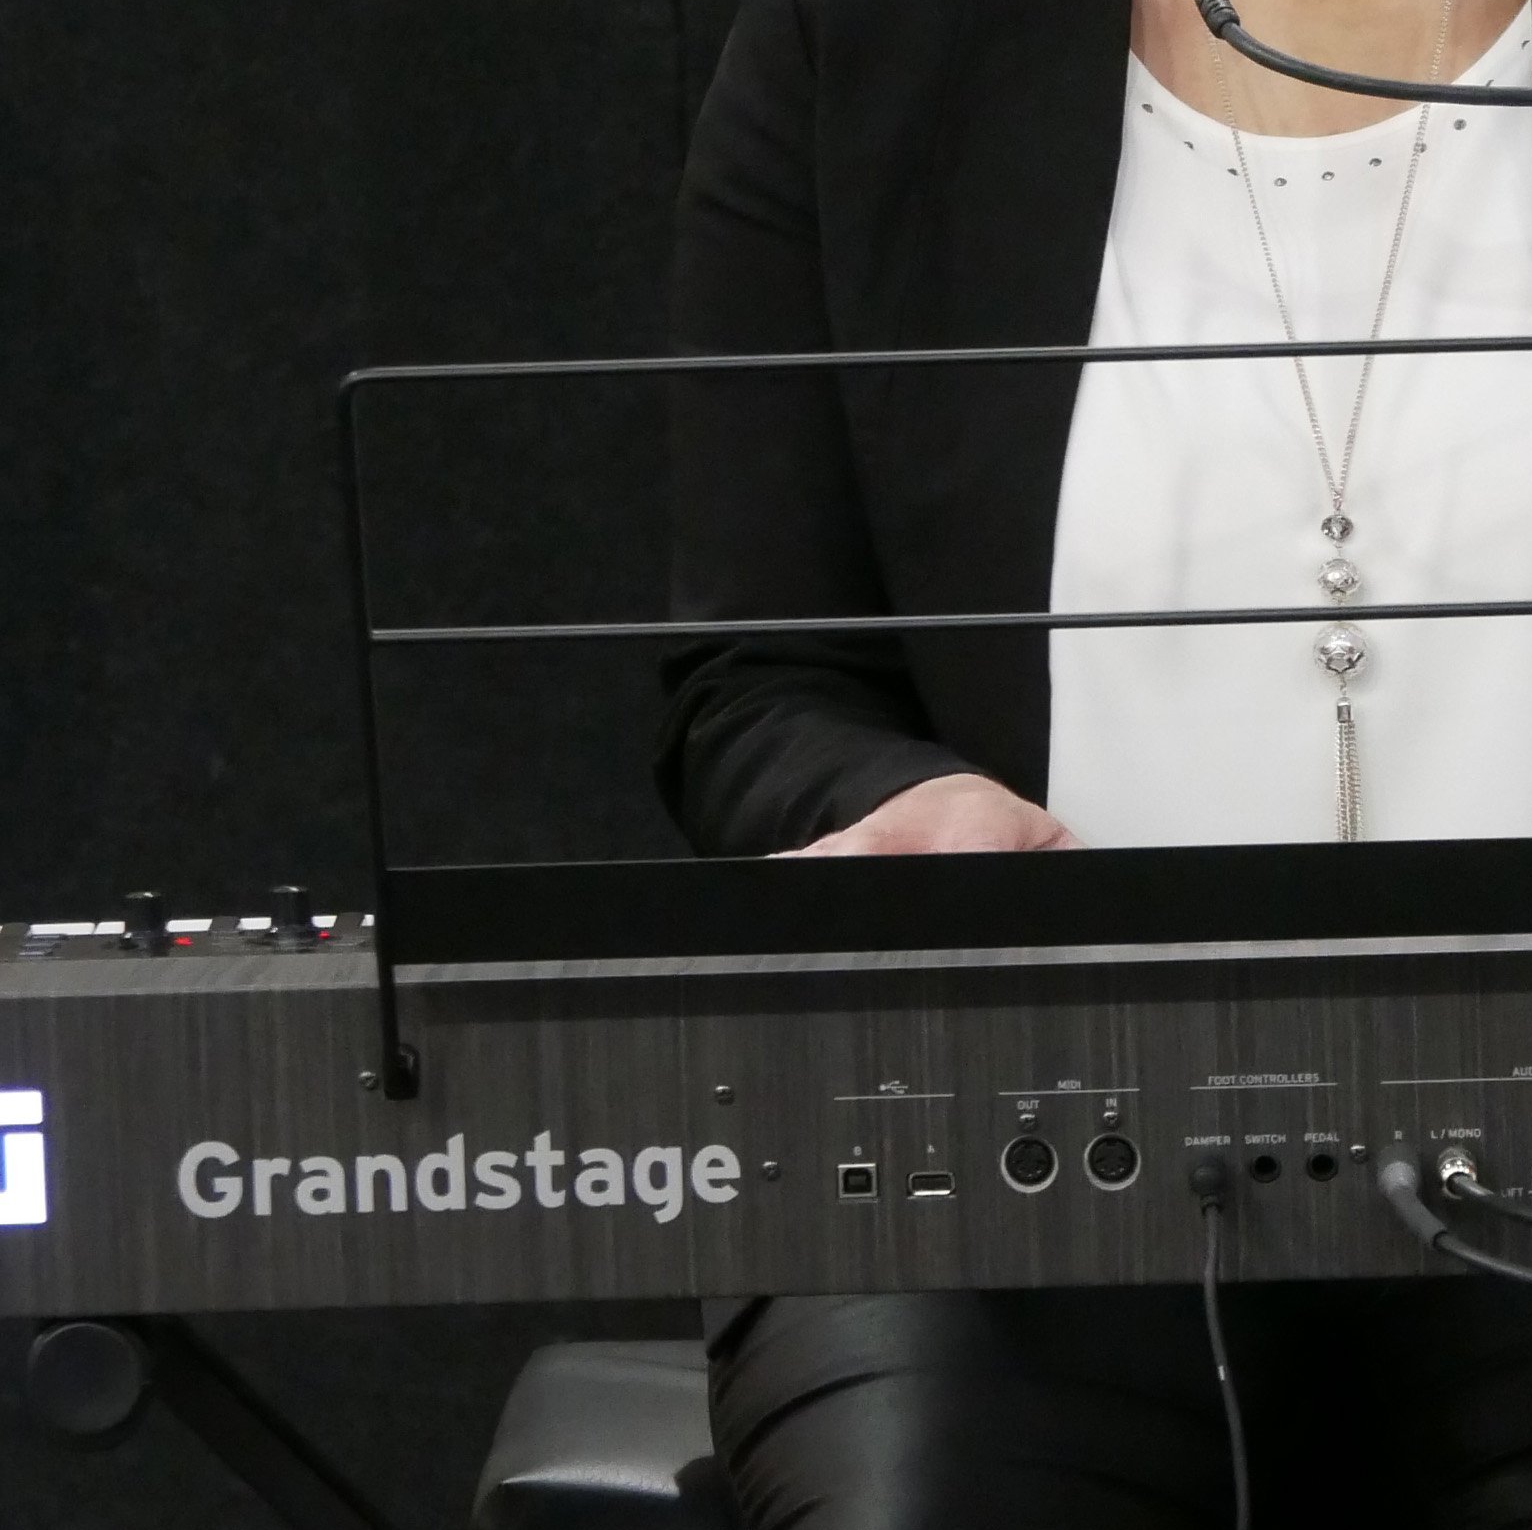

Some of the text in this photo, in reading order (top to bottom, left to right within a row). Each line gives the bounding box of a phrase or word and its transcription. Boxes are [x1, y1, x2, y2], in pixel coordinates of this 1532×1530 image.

[1057, 1079, 1082, 1090] MIDI
[1208, 1072, 1320, 1086] FOOT CONTROLLERS
[1017, 1099, 1040, 1110] OUT
[1105, 1097, 1118, 1108] IN
[1244, 1133, 1287, 1145] SWITCH
[1304, 1131, 1340, 1143] PEDAL
[1394, 1129, 1403, 1141] R
[1184, 1135, 1231, 1148] DAMPER
[177, 1130, 742, 1224] Grandstage
